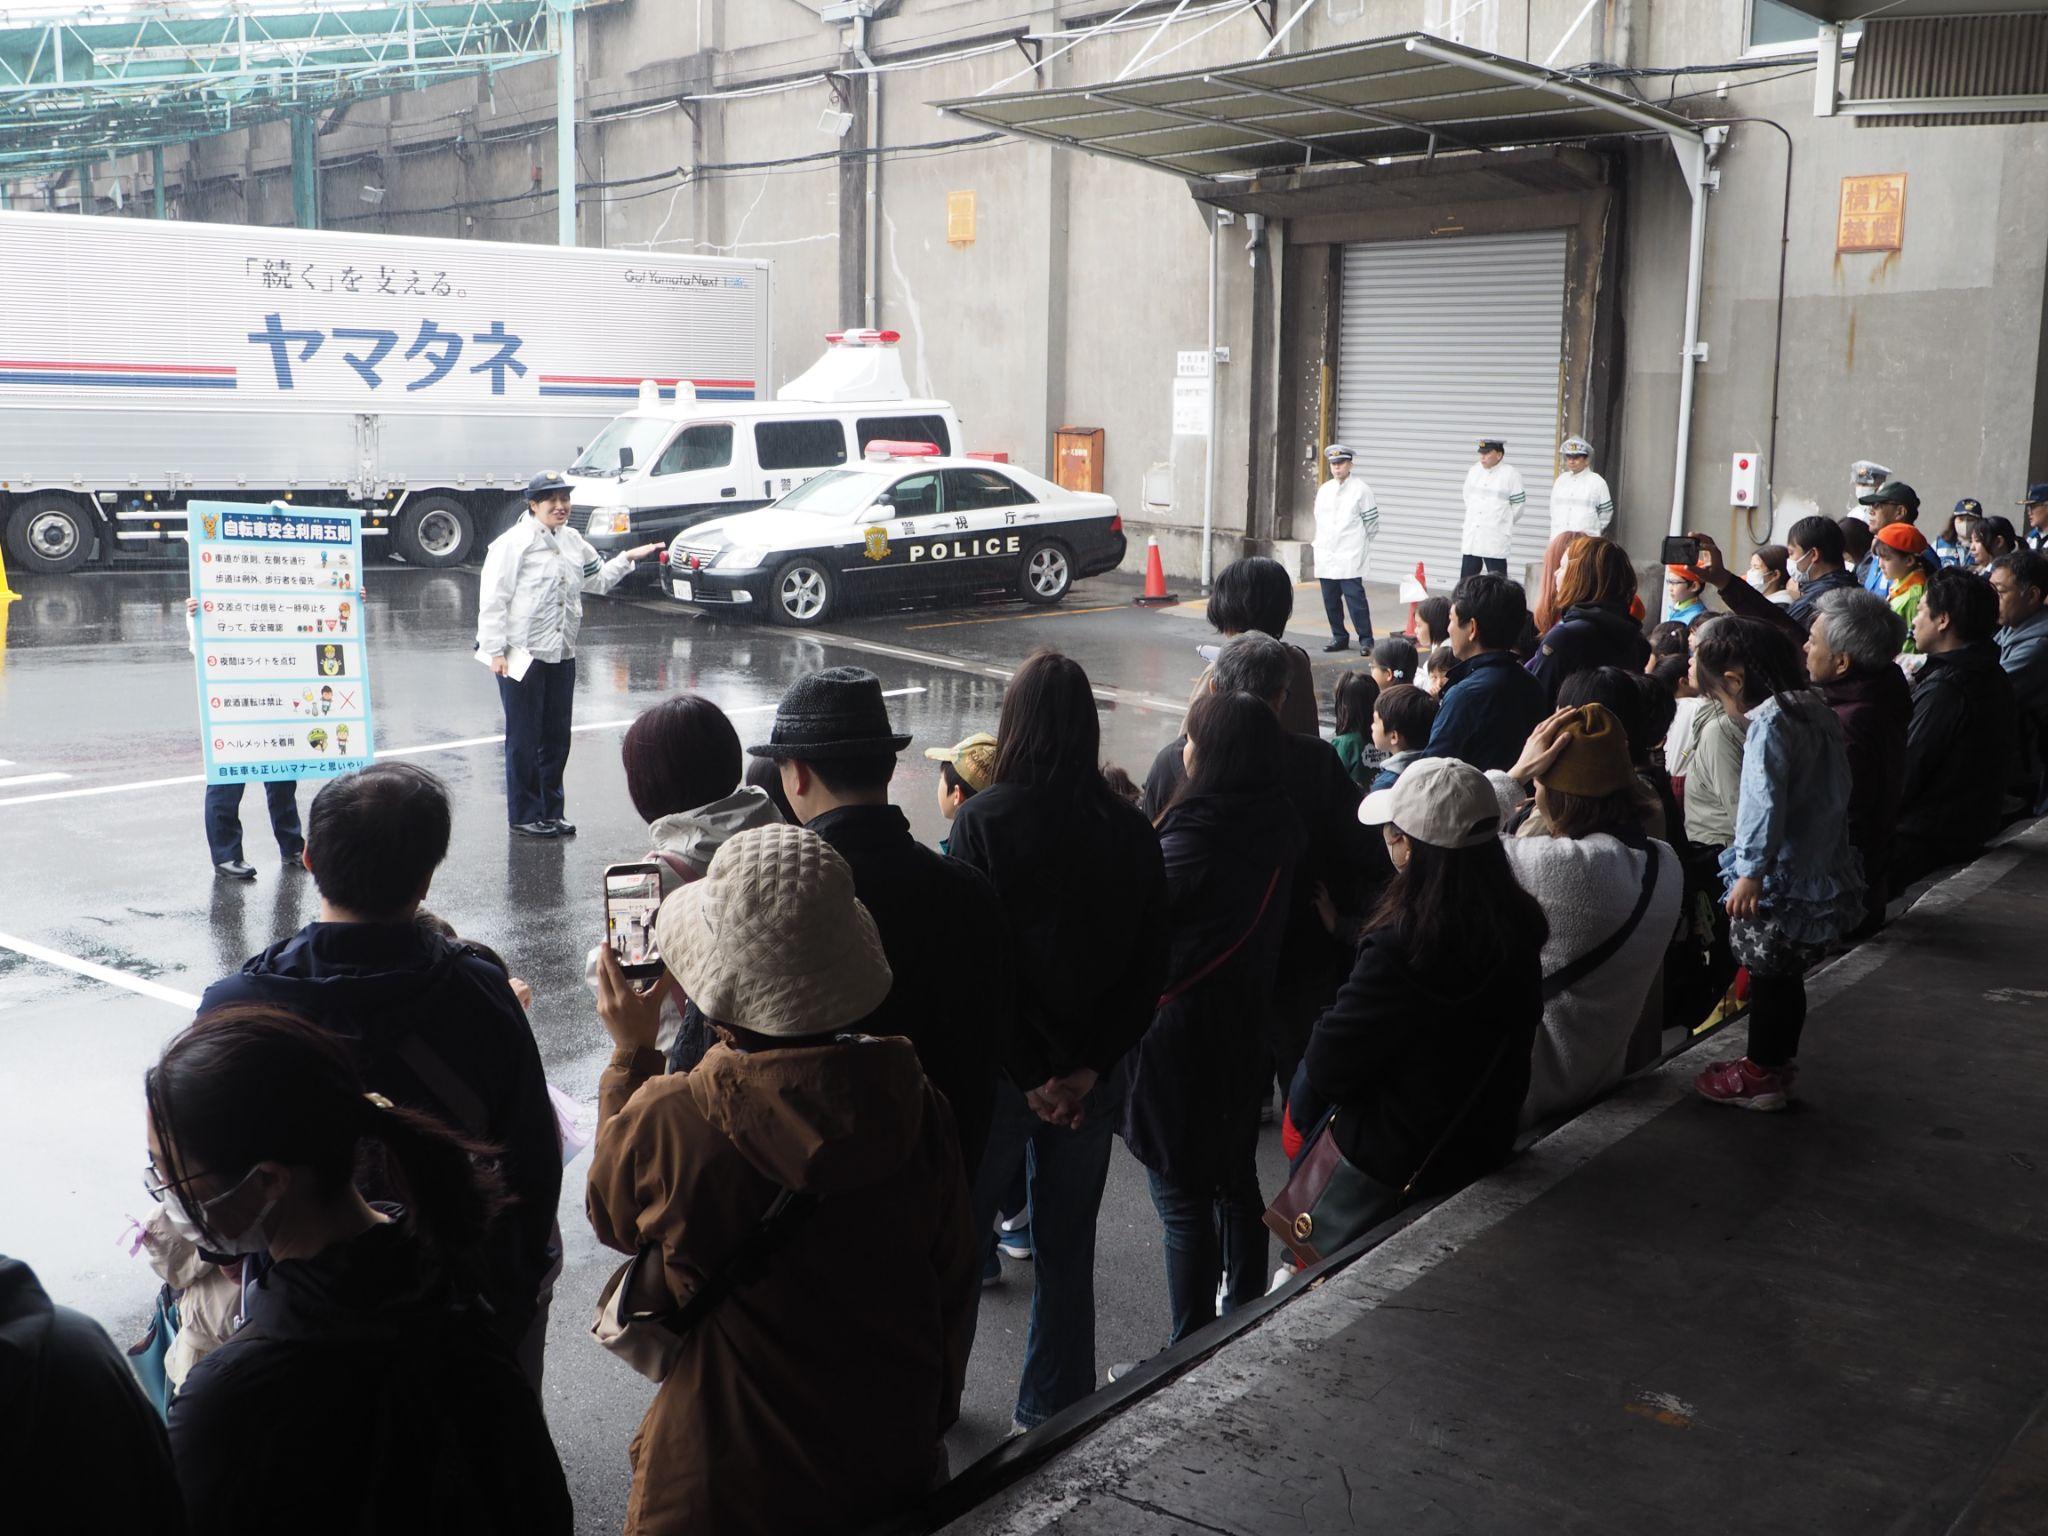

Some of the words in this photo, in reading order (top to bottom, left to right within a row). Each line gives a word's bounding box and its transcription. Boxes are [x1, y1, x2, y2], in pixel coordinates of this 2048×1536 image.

[246, 257, 468, 299] 「続く」を支える。
[247, 311, 529, 395] ヤマタネ
[224, 519, 351, 542] 自転車安全利用五則
[909, 535, 1021, 563] POLICE
